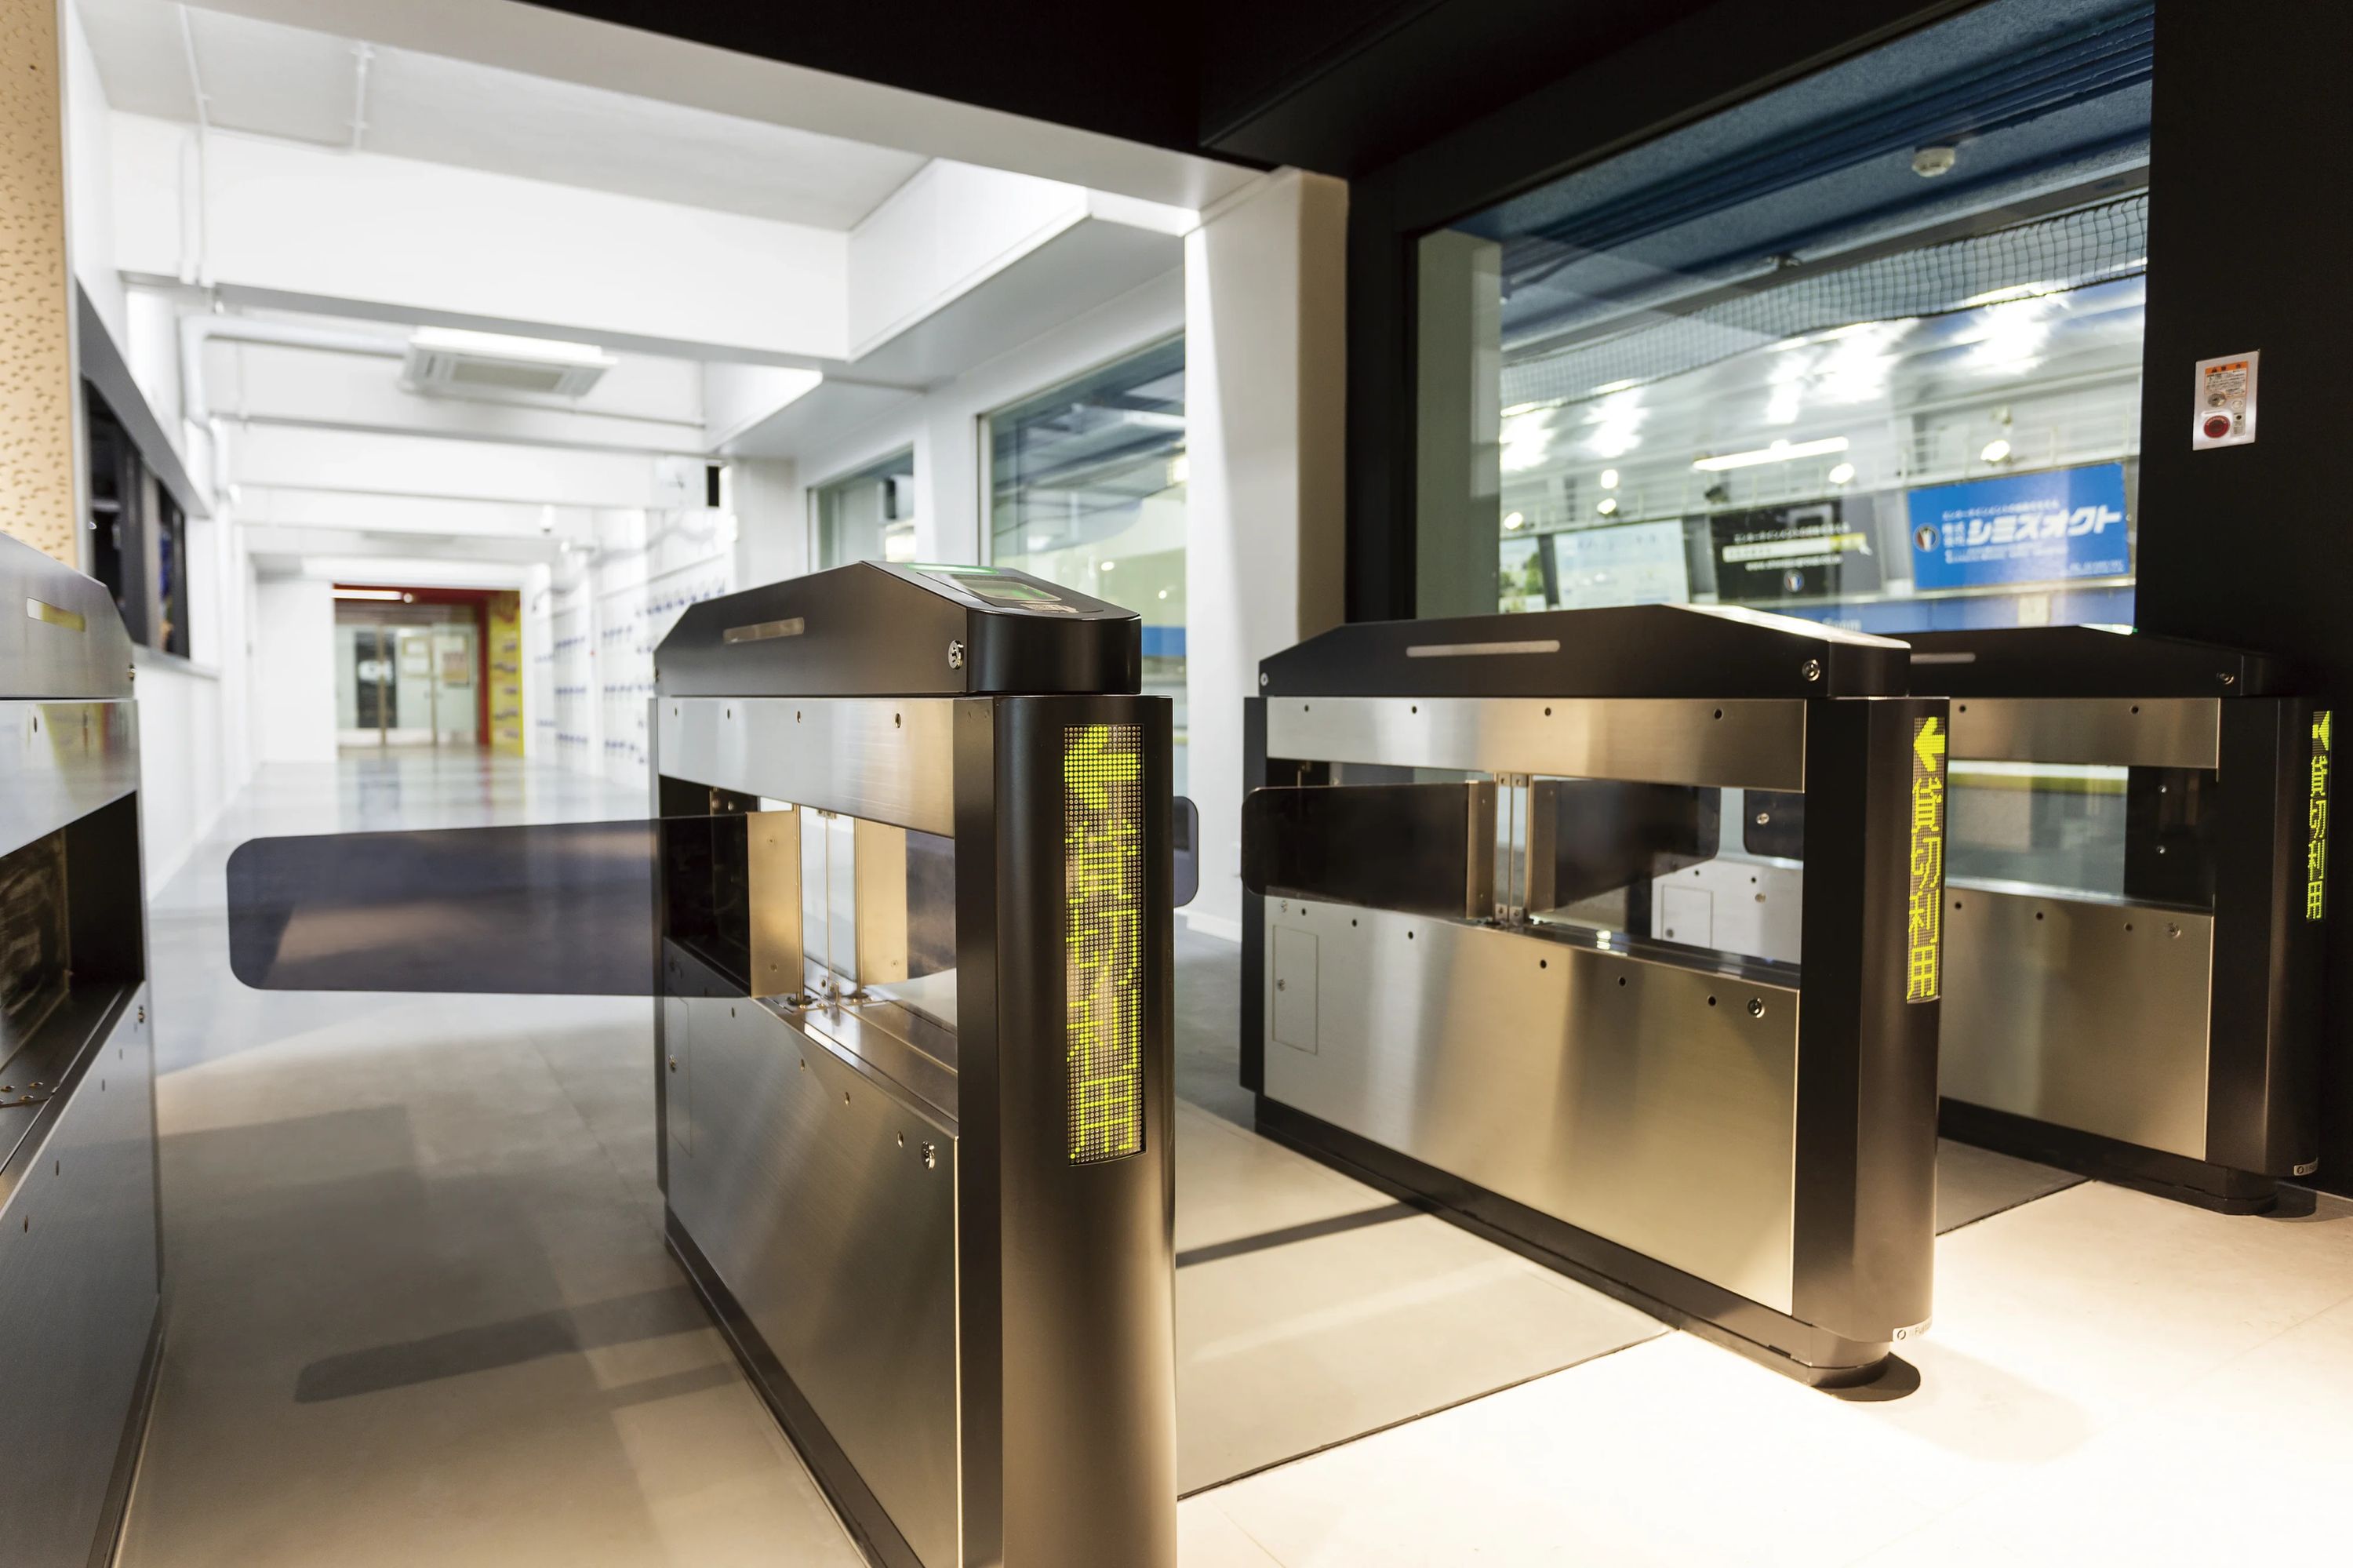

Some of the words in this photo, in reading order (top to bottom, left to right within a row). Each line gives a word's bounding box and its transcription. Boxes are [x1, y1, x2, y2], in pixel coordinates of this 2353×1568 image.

[1907, 777, 1942, 1000] 貸切利用
[2307, 755, 2328, 919] 貸切利用
[1065, 820, 1137, 1159] 貸切利用
